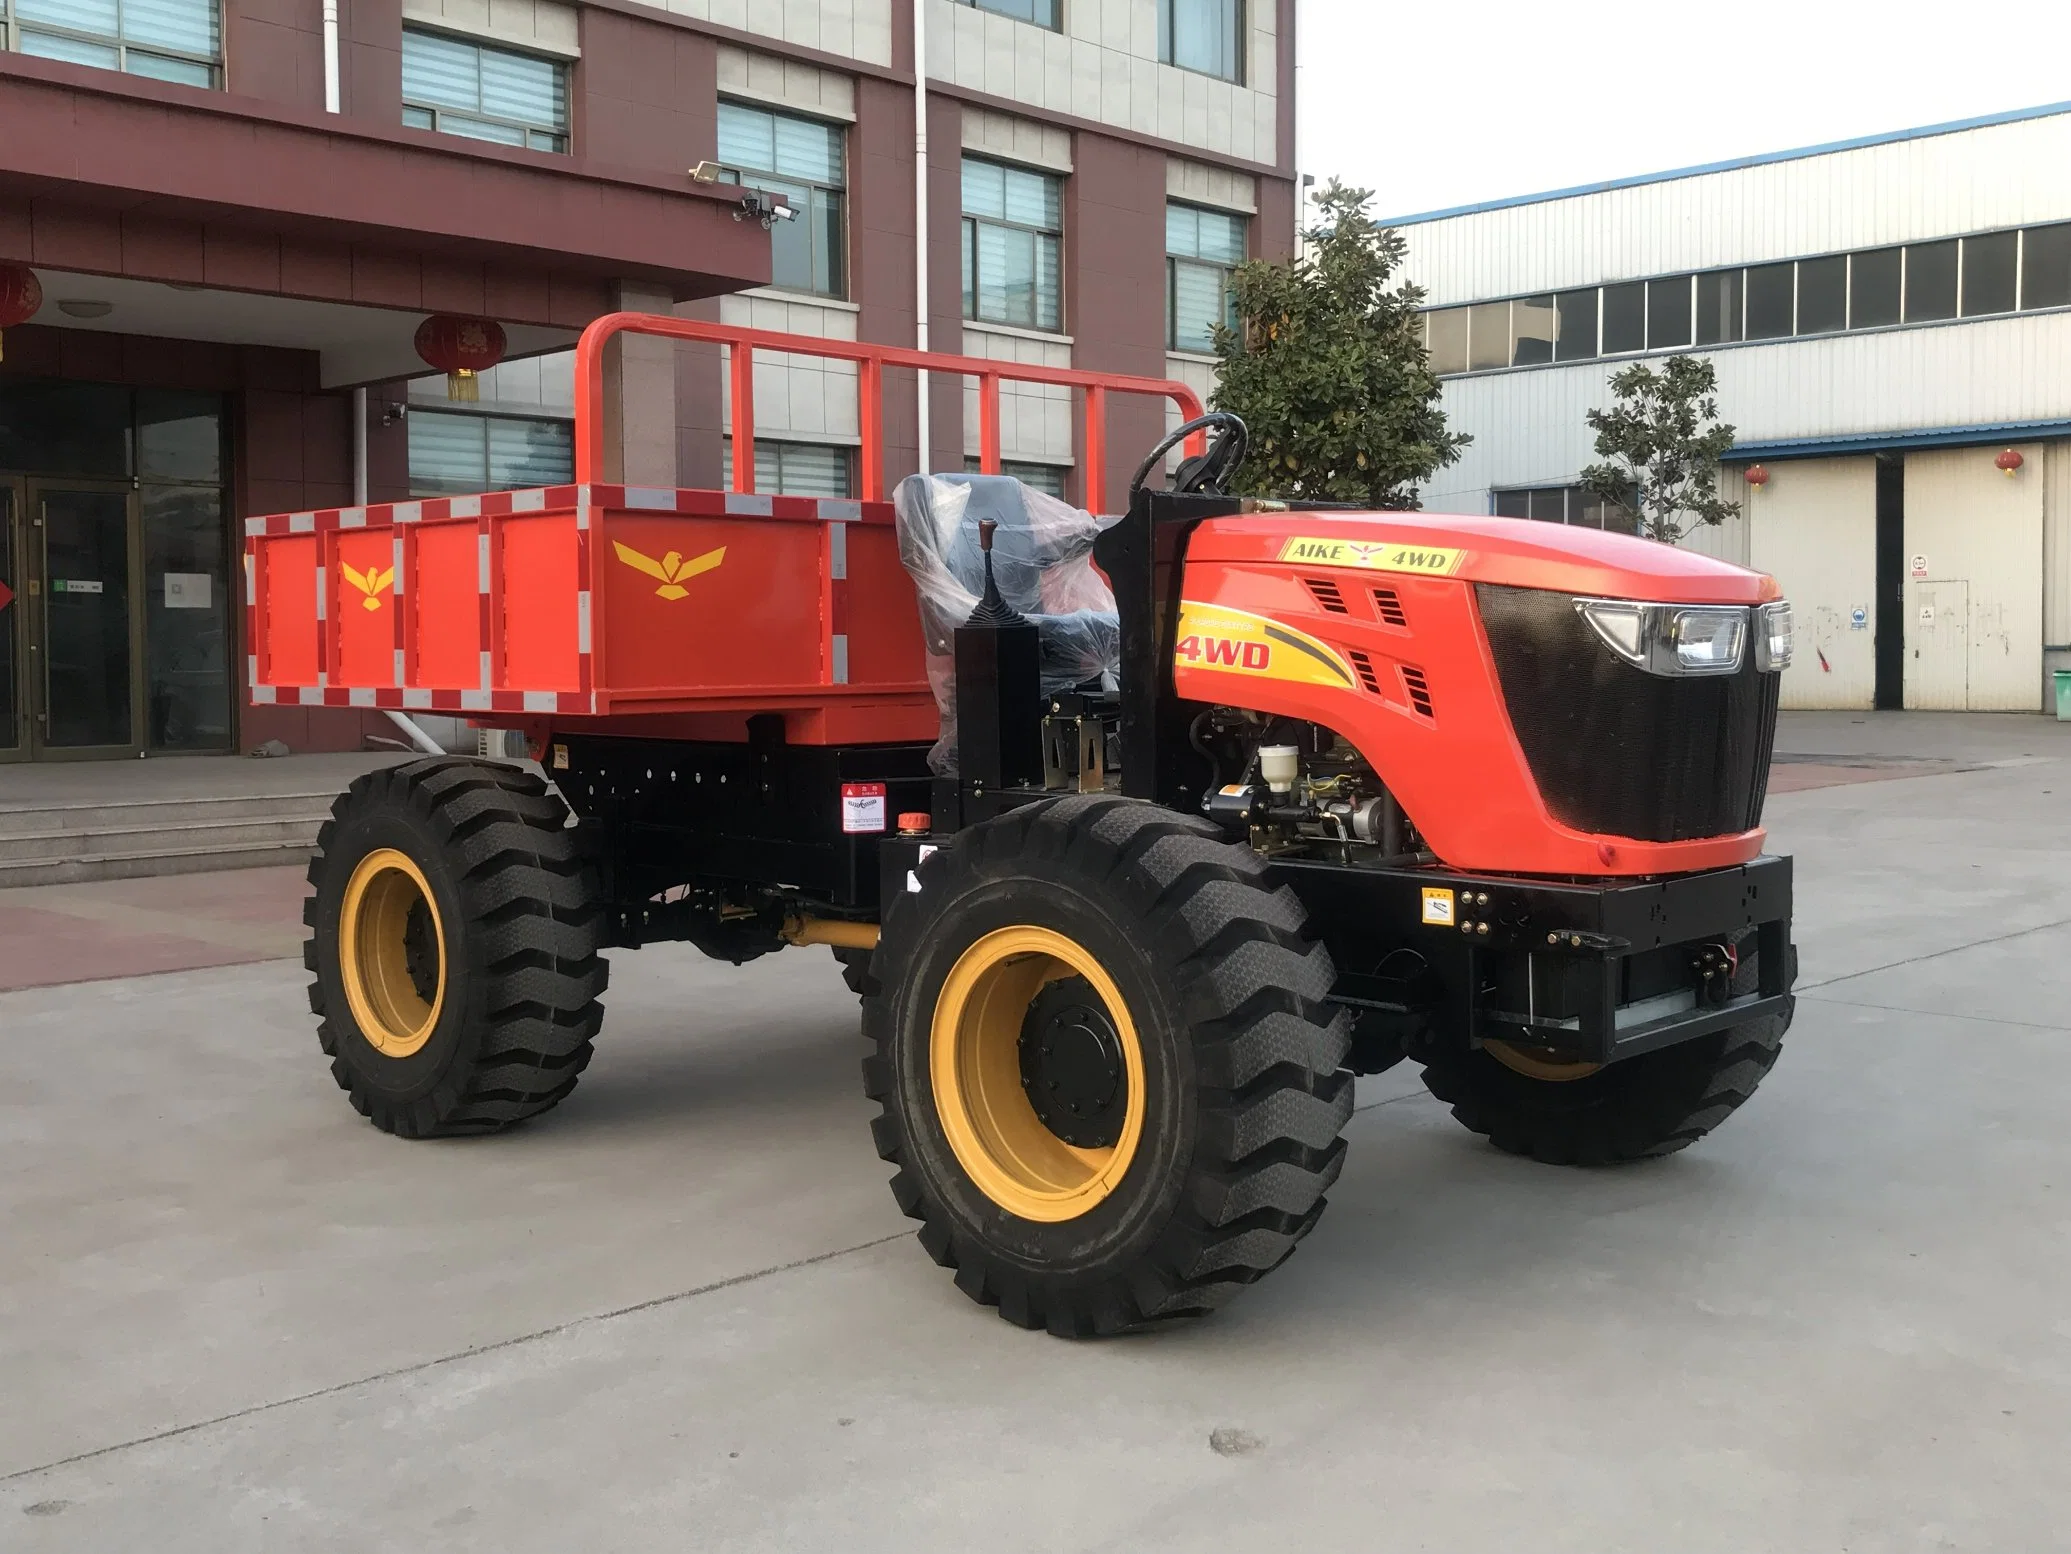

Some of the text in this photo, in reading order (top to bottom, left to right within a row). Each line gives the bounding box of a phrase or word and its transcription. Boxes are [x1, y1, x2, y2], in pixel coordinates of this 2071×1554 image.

[1292, 543, 1446, 568] AIKE 4WD
[1176, 635, 1270, 670] 4WD
